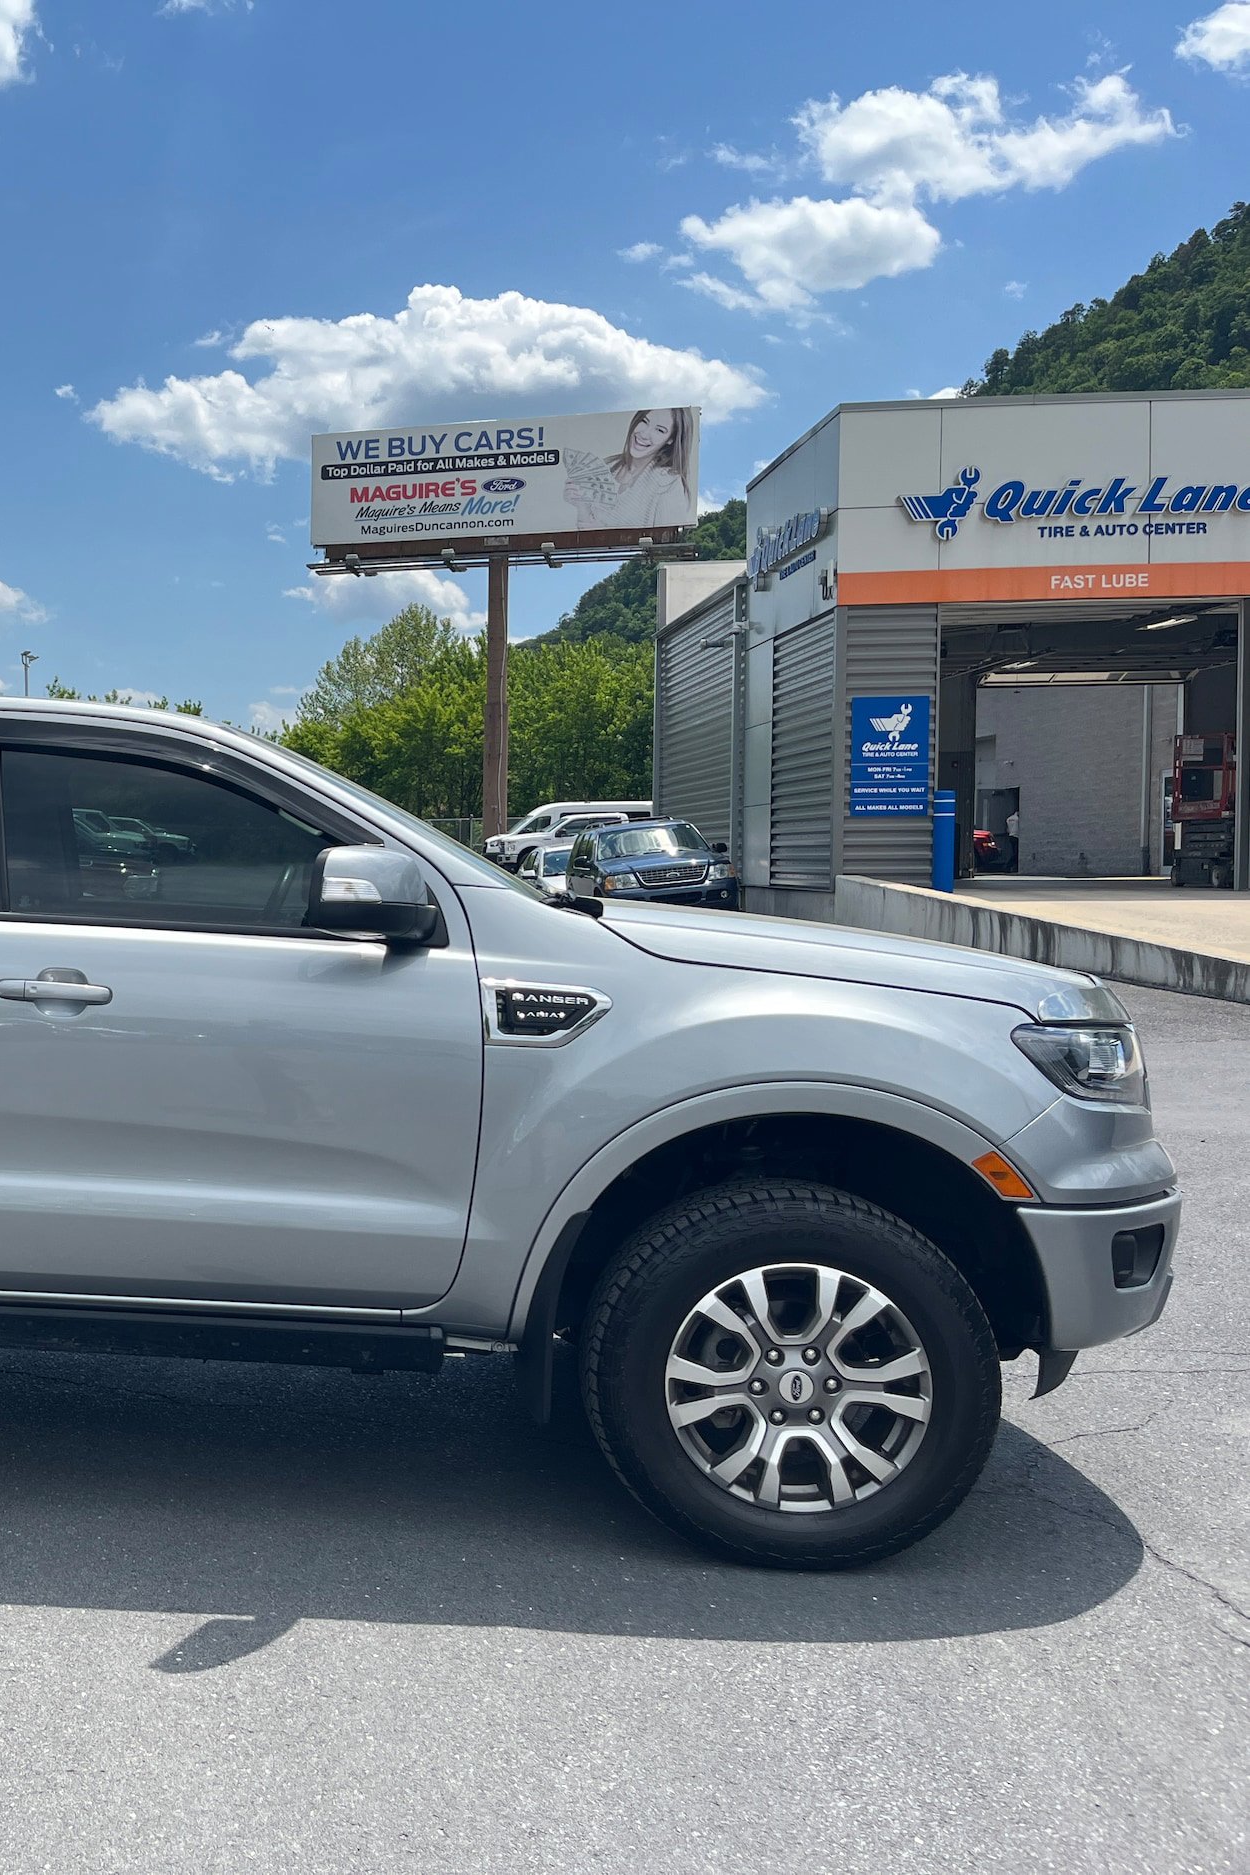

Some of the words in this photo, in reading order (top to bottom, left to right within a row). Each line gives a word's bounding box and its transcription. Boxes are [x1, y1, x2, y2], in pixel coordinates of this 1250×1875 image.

[336, 438, 380, 461] WE
[387, 434, 448, 458] BUY
[454, 426, 544, 453] CARS!
[326, 465, 348, 478] Top
[350, 463, 386, 475] Dollar
[388, 460, 415, 473] Paid
[416, 459, 434, 471] for
[436, 457, 453, 470] All
[455, 456, 495, 469] Makes
[496, 455, 507, 466] &
[509, 452, 556, 465] Models
[349, 477, 477, 503] MAGUIRE'S
[984, 477, 1138, 523] Quick
[355, 503, 416, 521] Maguire's
[418, 500, 461, 514] Means
[461, 494, 520, 516] More!
[360, 518, 514, 535] MaguiresDuncannon.com
[1038, 526, 1075, 538] TIRE
[1079, 525, 1090, 537] &
[1094, 524, 1139, 537] AUTO
[1142, 522, 1207, 535] CENTER
[1050, 575, 1096, 589] FAST
[1101, 573, 1149, 588] LUBE
[861, 742, 892, 752] Quick
[892, 742, 919, 751] Lane
[512, 992, 589, 1005] RANGER
